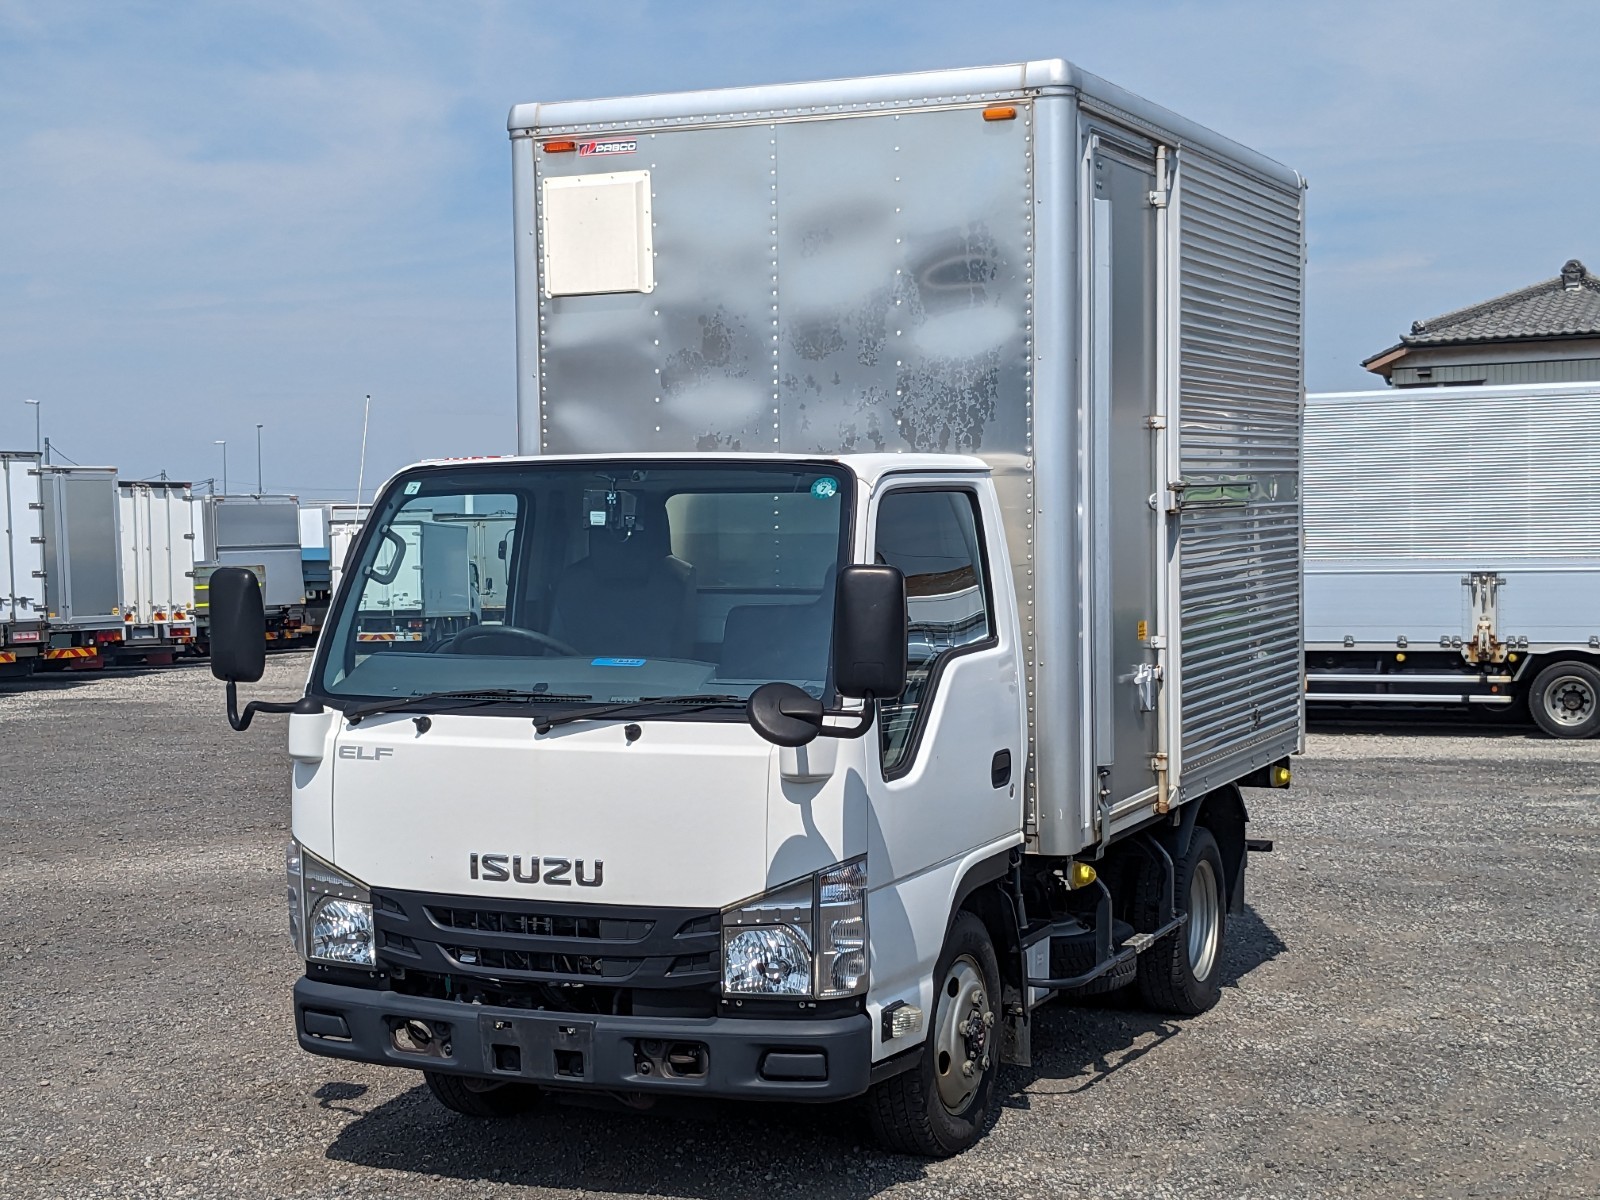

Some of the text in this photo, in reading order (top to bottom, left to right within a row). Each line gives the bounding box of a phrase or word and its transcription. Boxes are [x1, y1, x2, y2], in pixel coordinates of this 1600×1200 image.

[596, 142, 636, 152] PABCO
[338, 745, 394, 761] ELF
[470, 852, 604, 887] ISUZU
